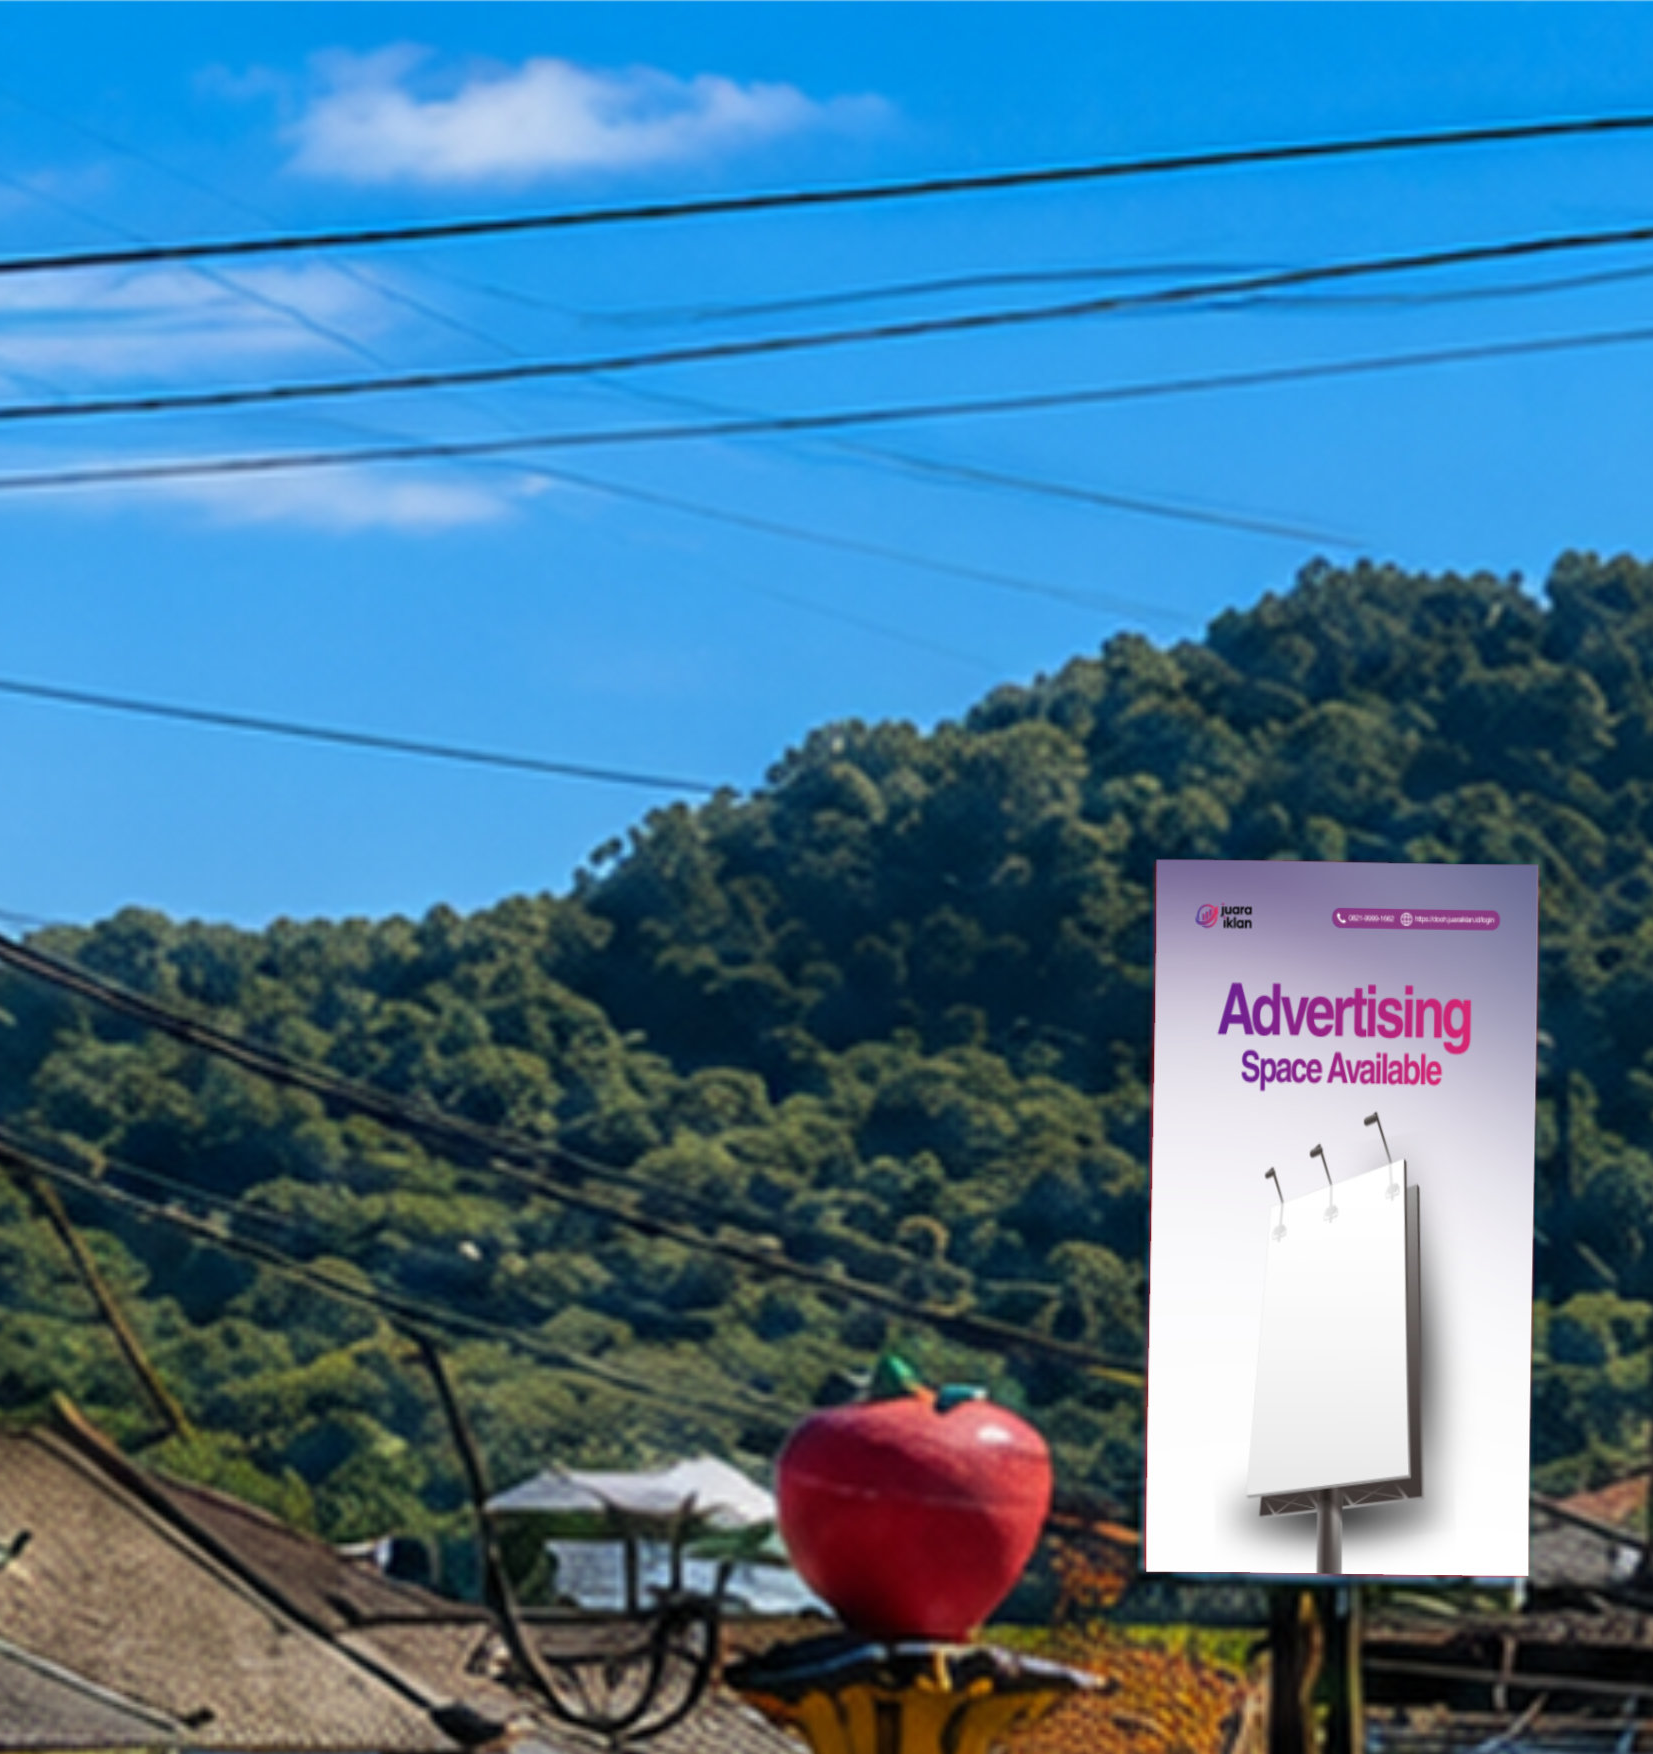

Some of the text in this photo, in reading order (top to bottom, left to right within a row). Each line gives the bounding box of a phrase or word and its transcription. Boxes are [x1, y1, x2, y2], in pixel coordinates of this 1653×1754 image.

[1221, 901, 1253, 917] juara
[1223, 915, 1253, 929] iklan
[1218, 982, 1472, 1055] Advertising
[1241, 1049, 1443, 1092] Space Available
